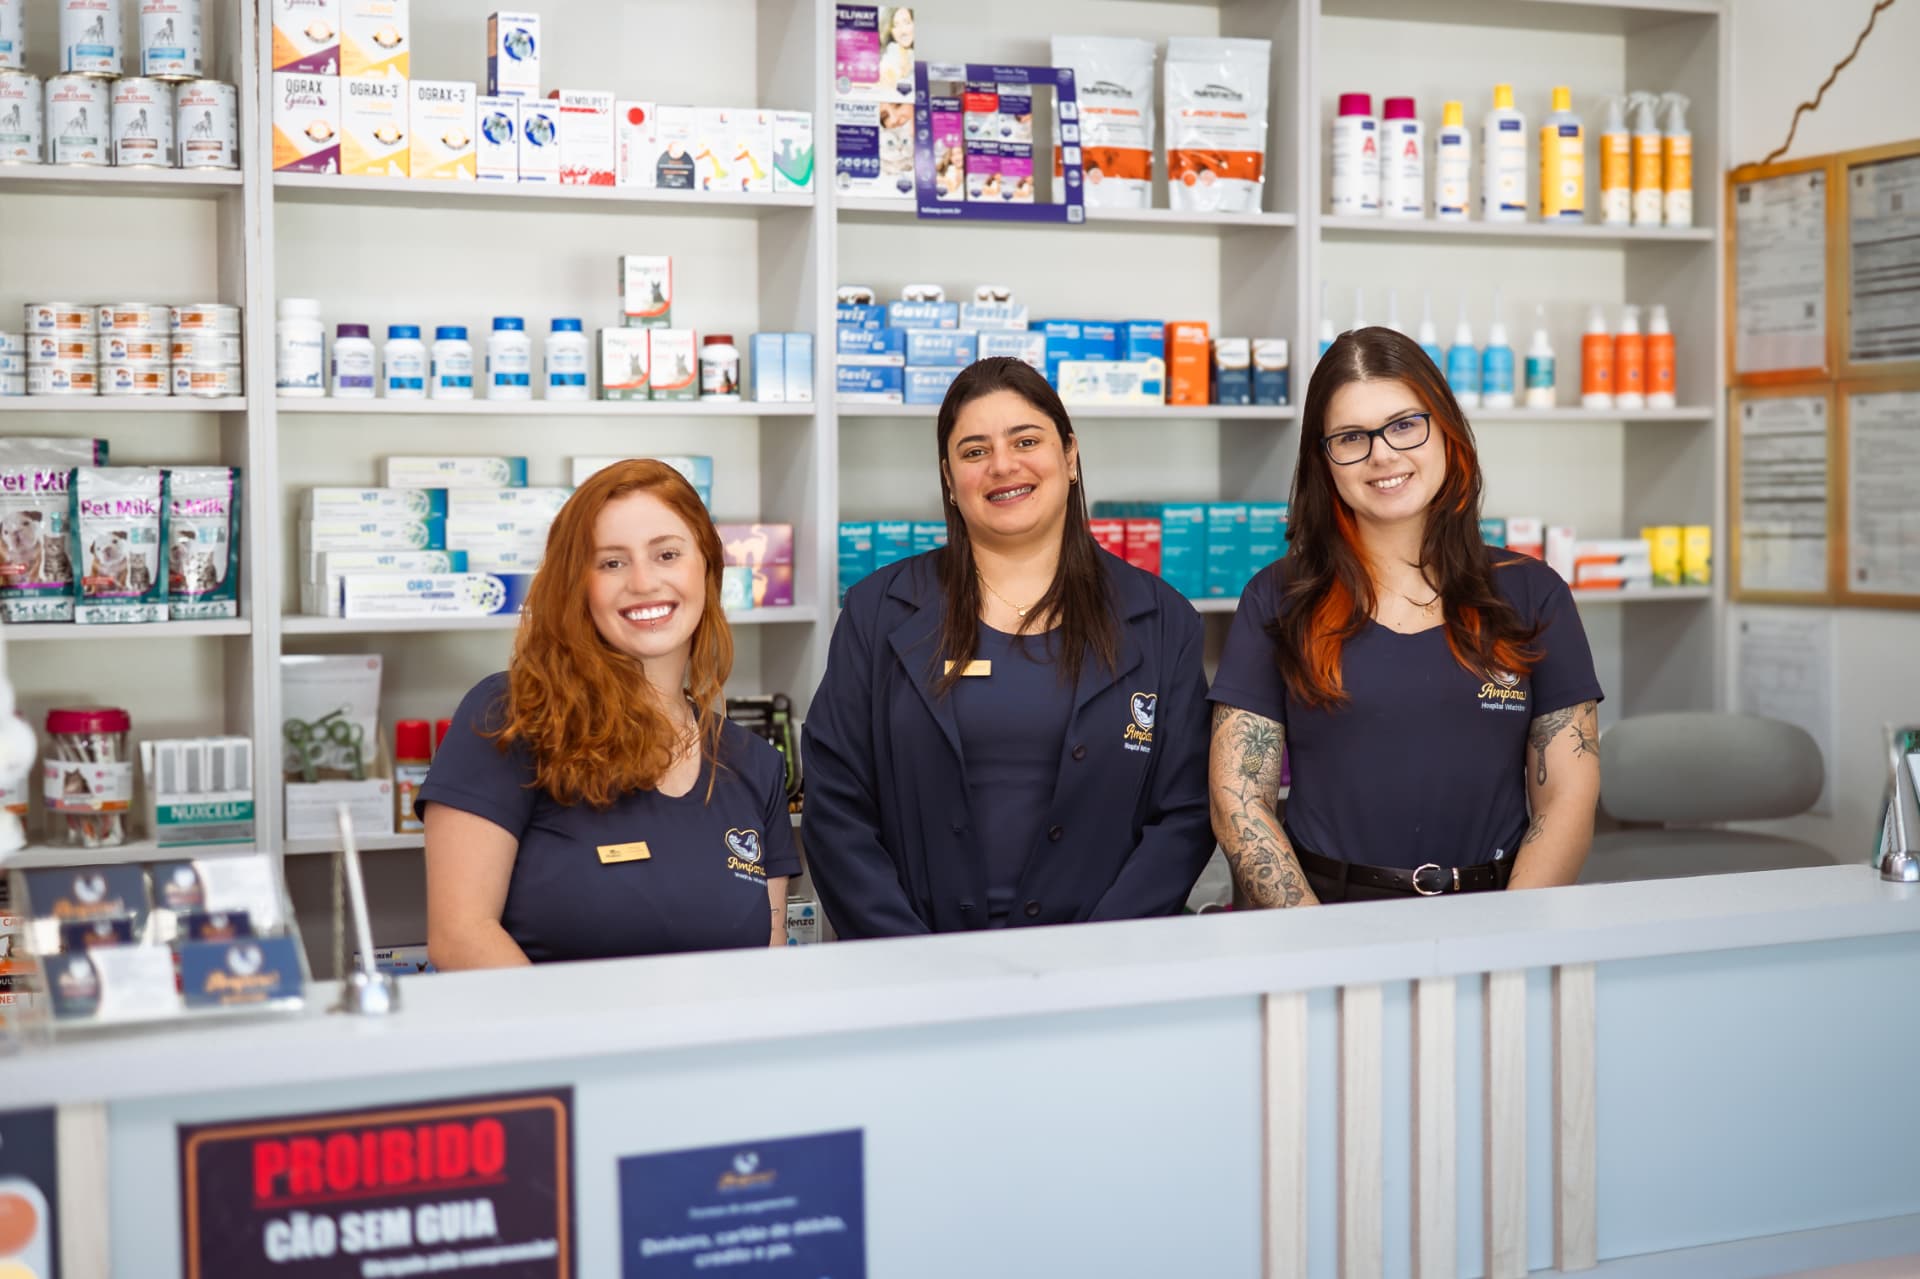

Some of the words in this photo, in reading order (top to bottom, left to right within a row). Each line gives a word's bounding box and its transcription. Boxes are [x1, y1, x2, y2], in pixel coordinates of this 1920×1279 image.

[286, 79, 322, 95] OGRAX
[350, 82, 398, 98] OGRAX-3
[418, 87, 466, 103] OGRAX-3
[835, 103, 876, 112] FELIWAY
[837, 306, 866, 321] aviz
[891, 302, 940, 319] Gaviz
[840, 329, 874, 343] Gaviz
[838, 367, 872, 380] Gaviz
[0, 471, 27, 491] et
[81, 500, 109, 516] Pet
[116, 499, 156, 516] Milk
[787, 916, 815, 929] fenza
[253, 1117, 507, 1201] PROIBIDO
[264, 1210, 338, 1263] CÃO
[340, 1206, 413, 1254] SEM
[415, 1198, 497, 1245] GUIA
